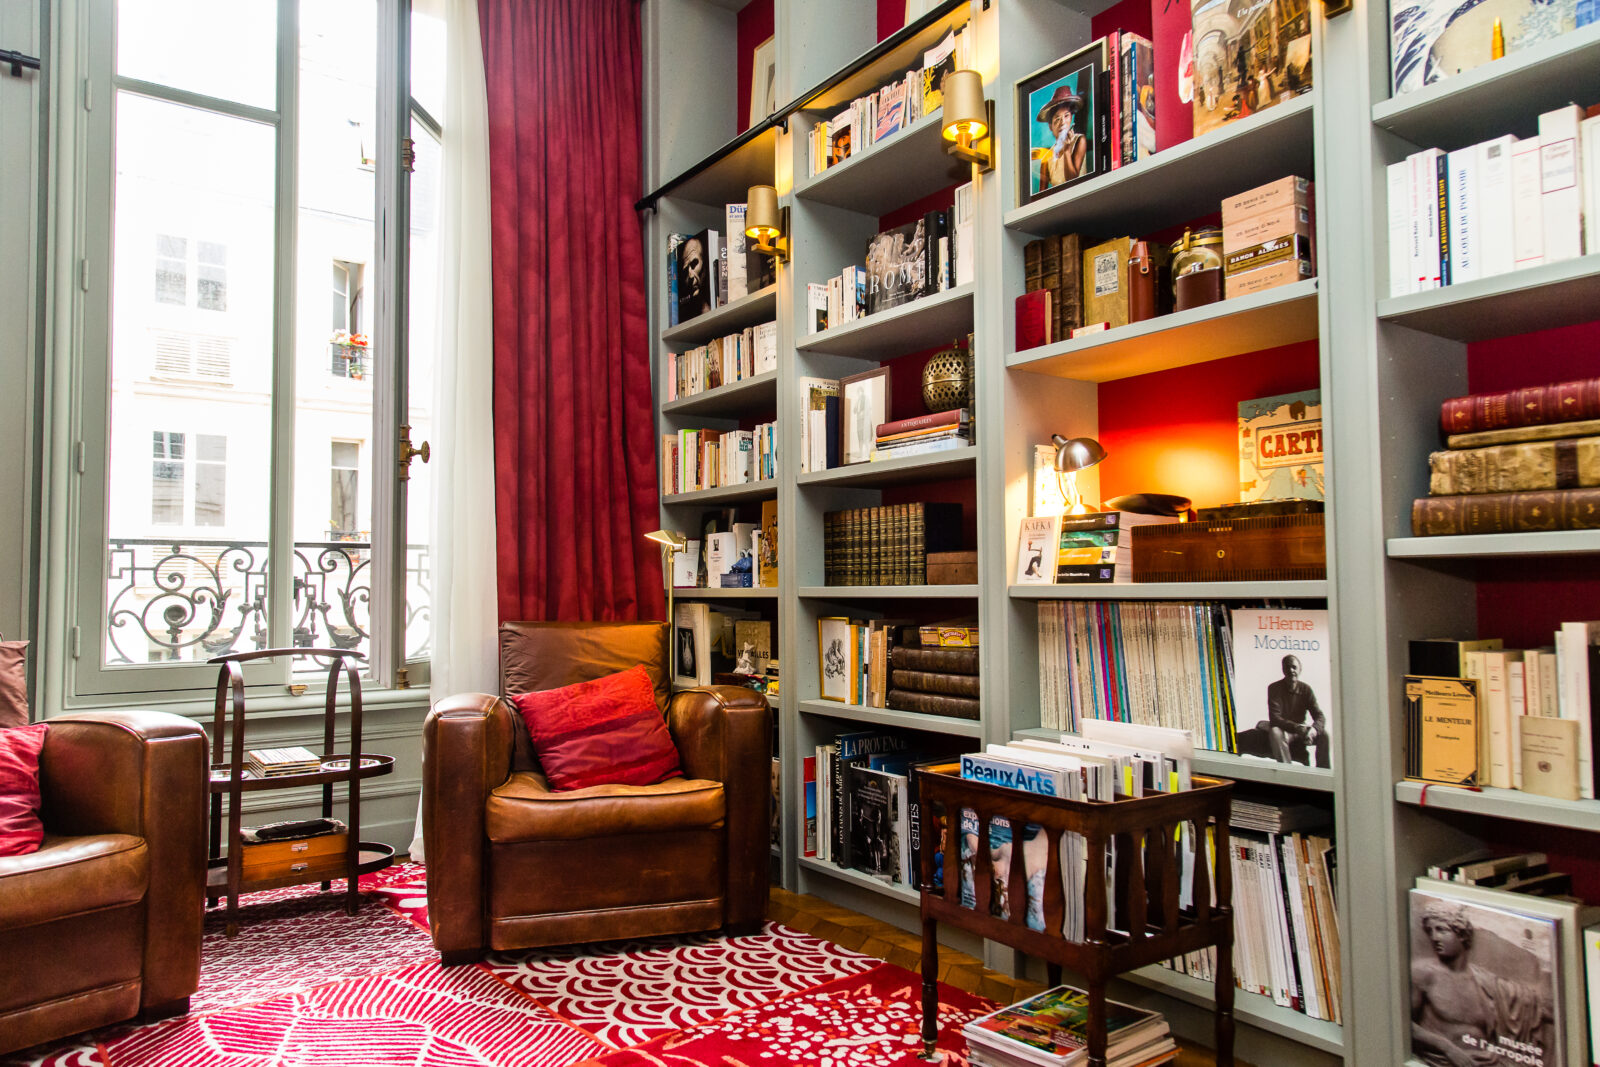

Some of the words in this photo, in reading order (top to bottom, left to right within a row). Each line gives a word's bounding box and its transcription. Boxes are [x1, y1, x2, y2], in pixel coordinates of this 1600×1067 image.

[870, 261, 926, 295] ROME
[1024, 521, 1051, 532] KAFKA
[1257, 615, 1314, 631] L'Herne
[1253, 634, 1320, 651] Modiano
[737, 649, 769, 659] VEAILLES
[1424, 715, 1433, 723] LE
[1436, 716, 1472, 726] MENTEUR
[1461, 1034, 1478, 1047] de
[1498, 1035, 1544, 1057] musée
